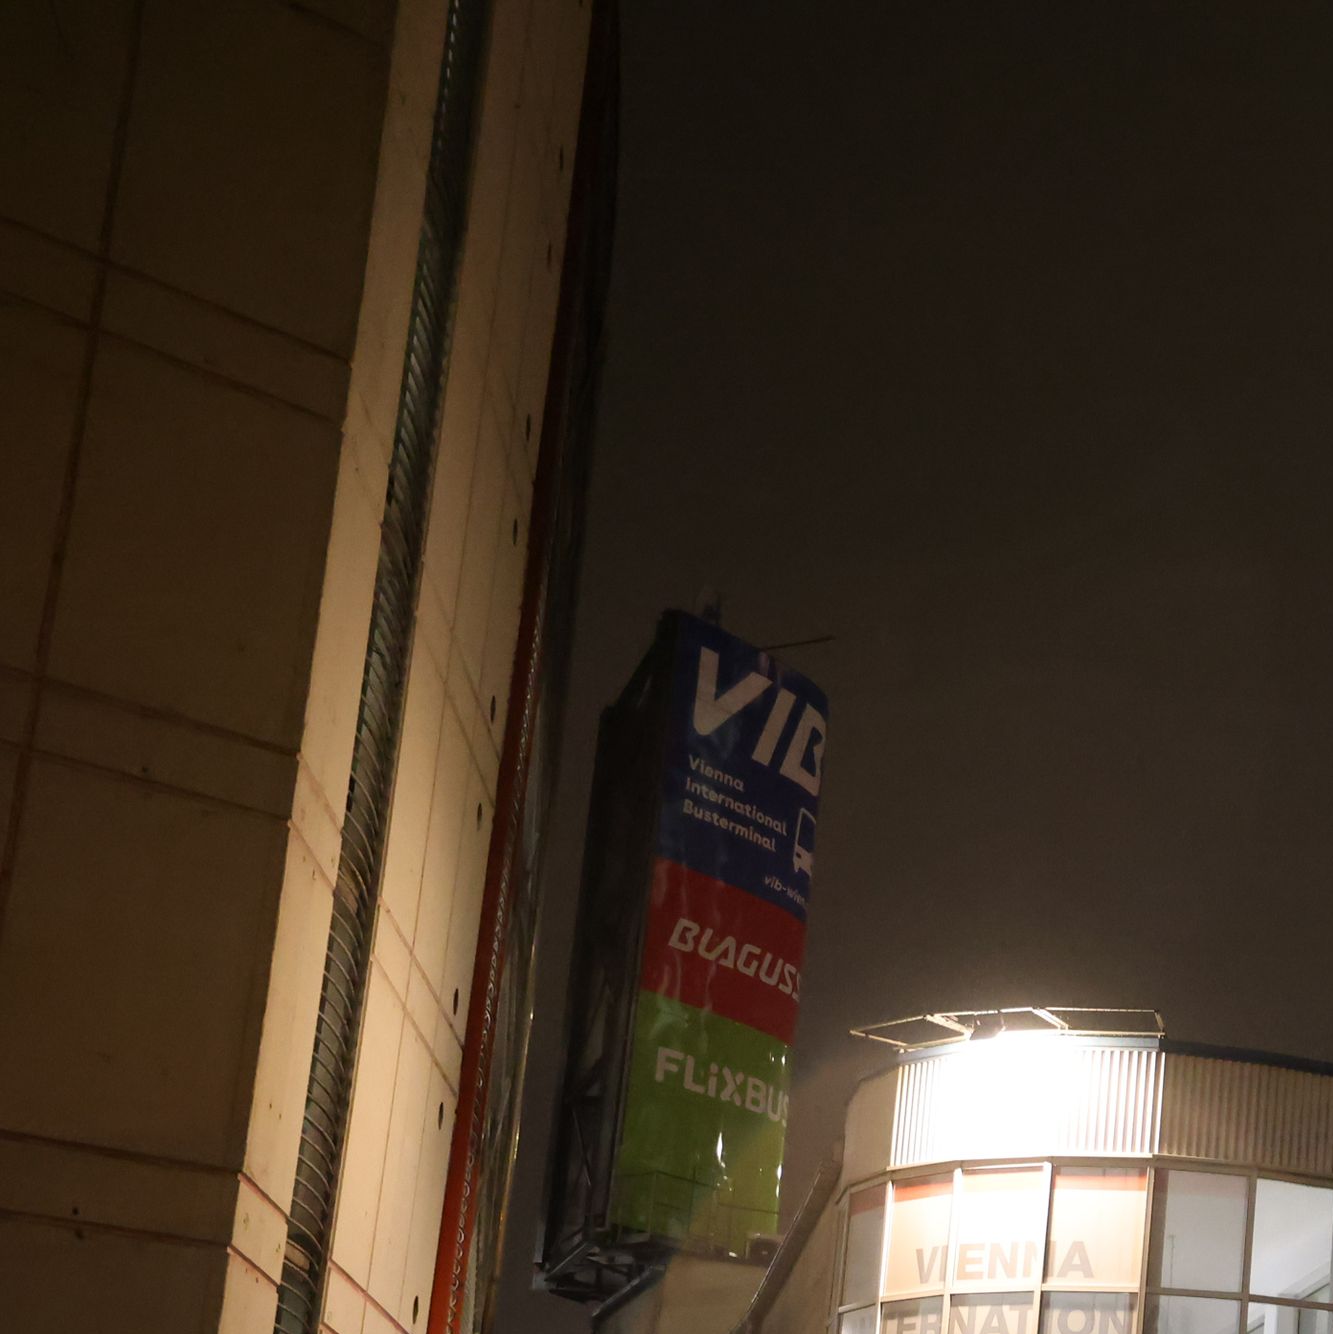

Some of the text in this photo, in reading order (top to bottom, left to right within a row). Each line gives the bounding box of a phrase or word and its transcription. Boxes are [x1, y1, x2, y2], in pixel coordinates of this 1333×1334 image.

[693, 646, 826, 796] VIB
[689, 754, 745, 792] Vienna
[682, 799, 777, 852] Busterminal
[685, 777, 788, 836] International
[916, 1240, 1094, 1284] VIENNA
